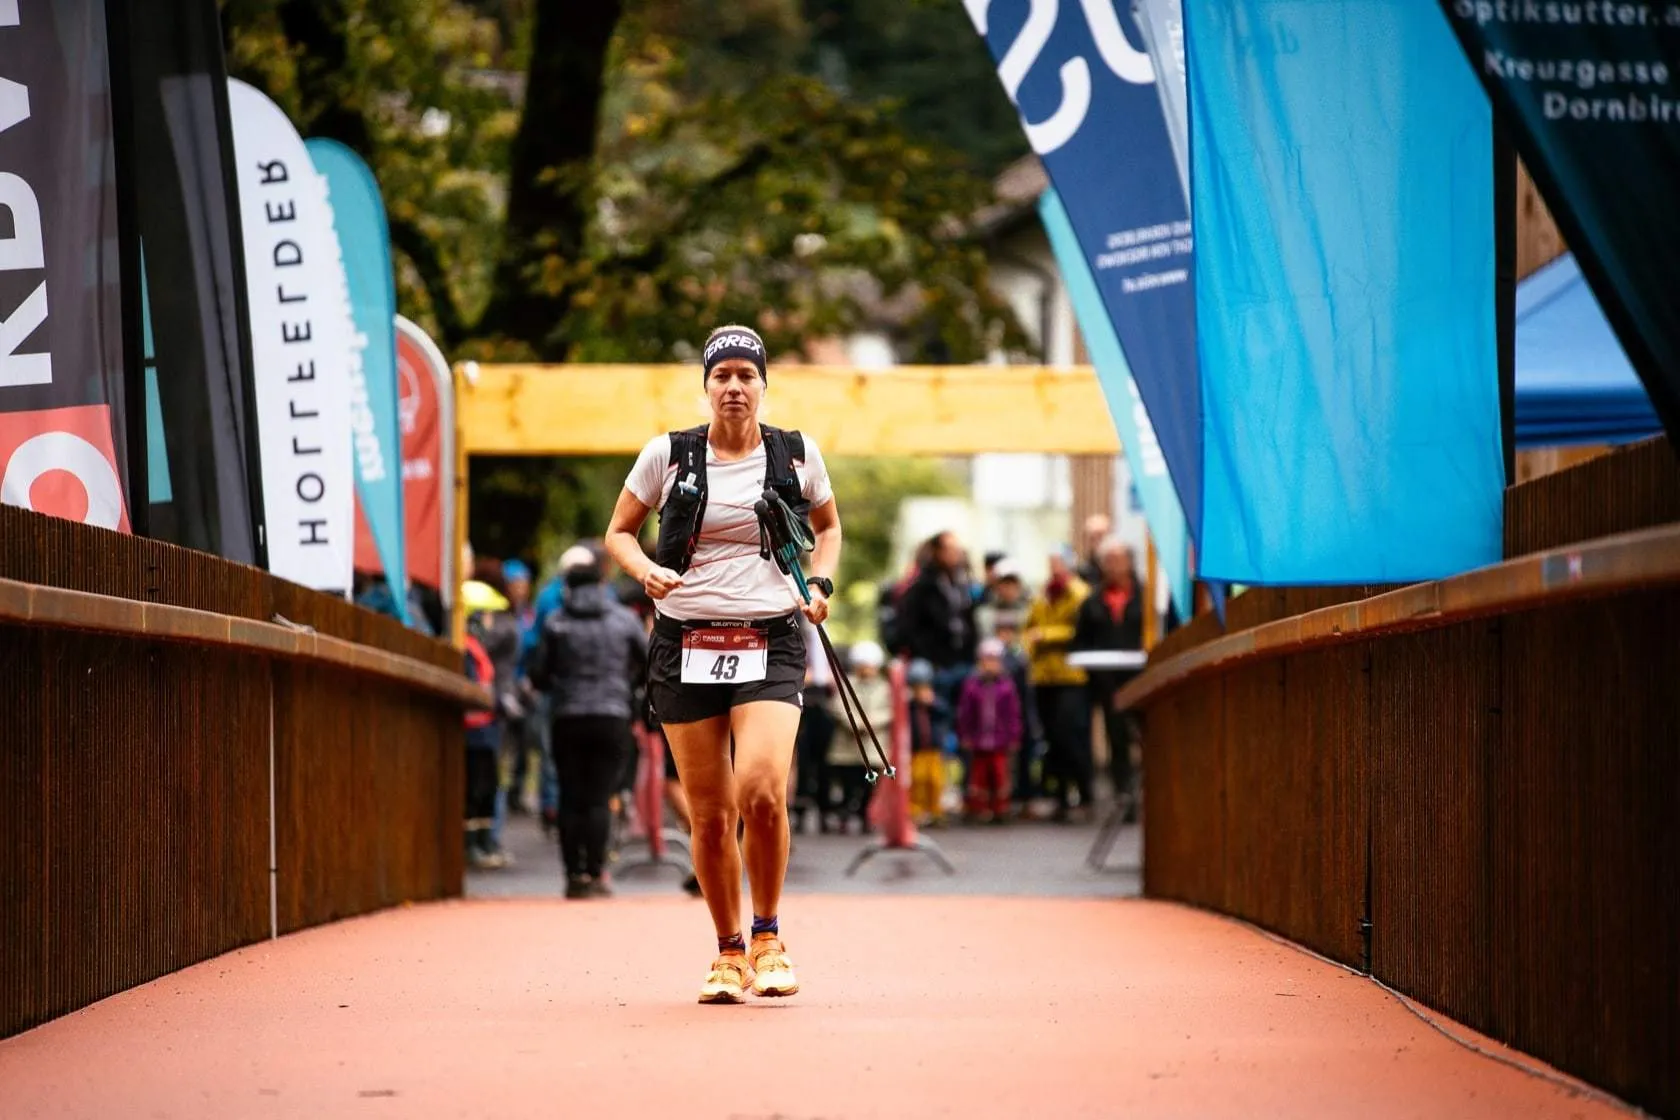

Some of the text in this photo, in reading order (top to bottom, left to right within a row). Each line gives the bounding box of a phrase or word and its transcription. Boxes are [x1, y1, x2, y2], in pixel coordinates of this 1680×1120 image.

[1485, 51, 1669, 88] Kreuzgasse
[1543, 92, 1680, 122] Dornbir
[710, 655, 740, 680] 43
